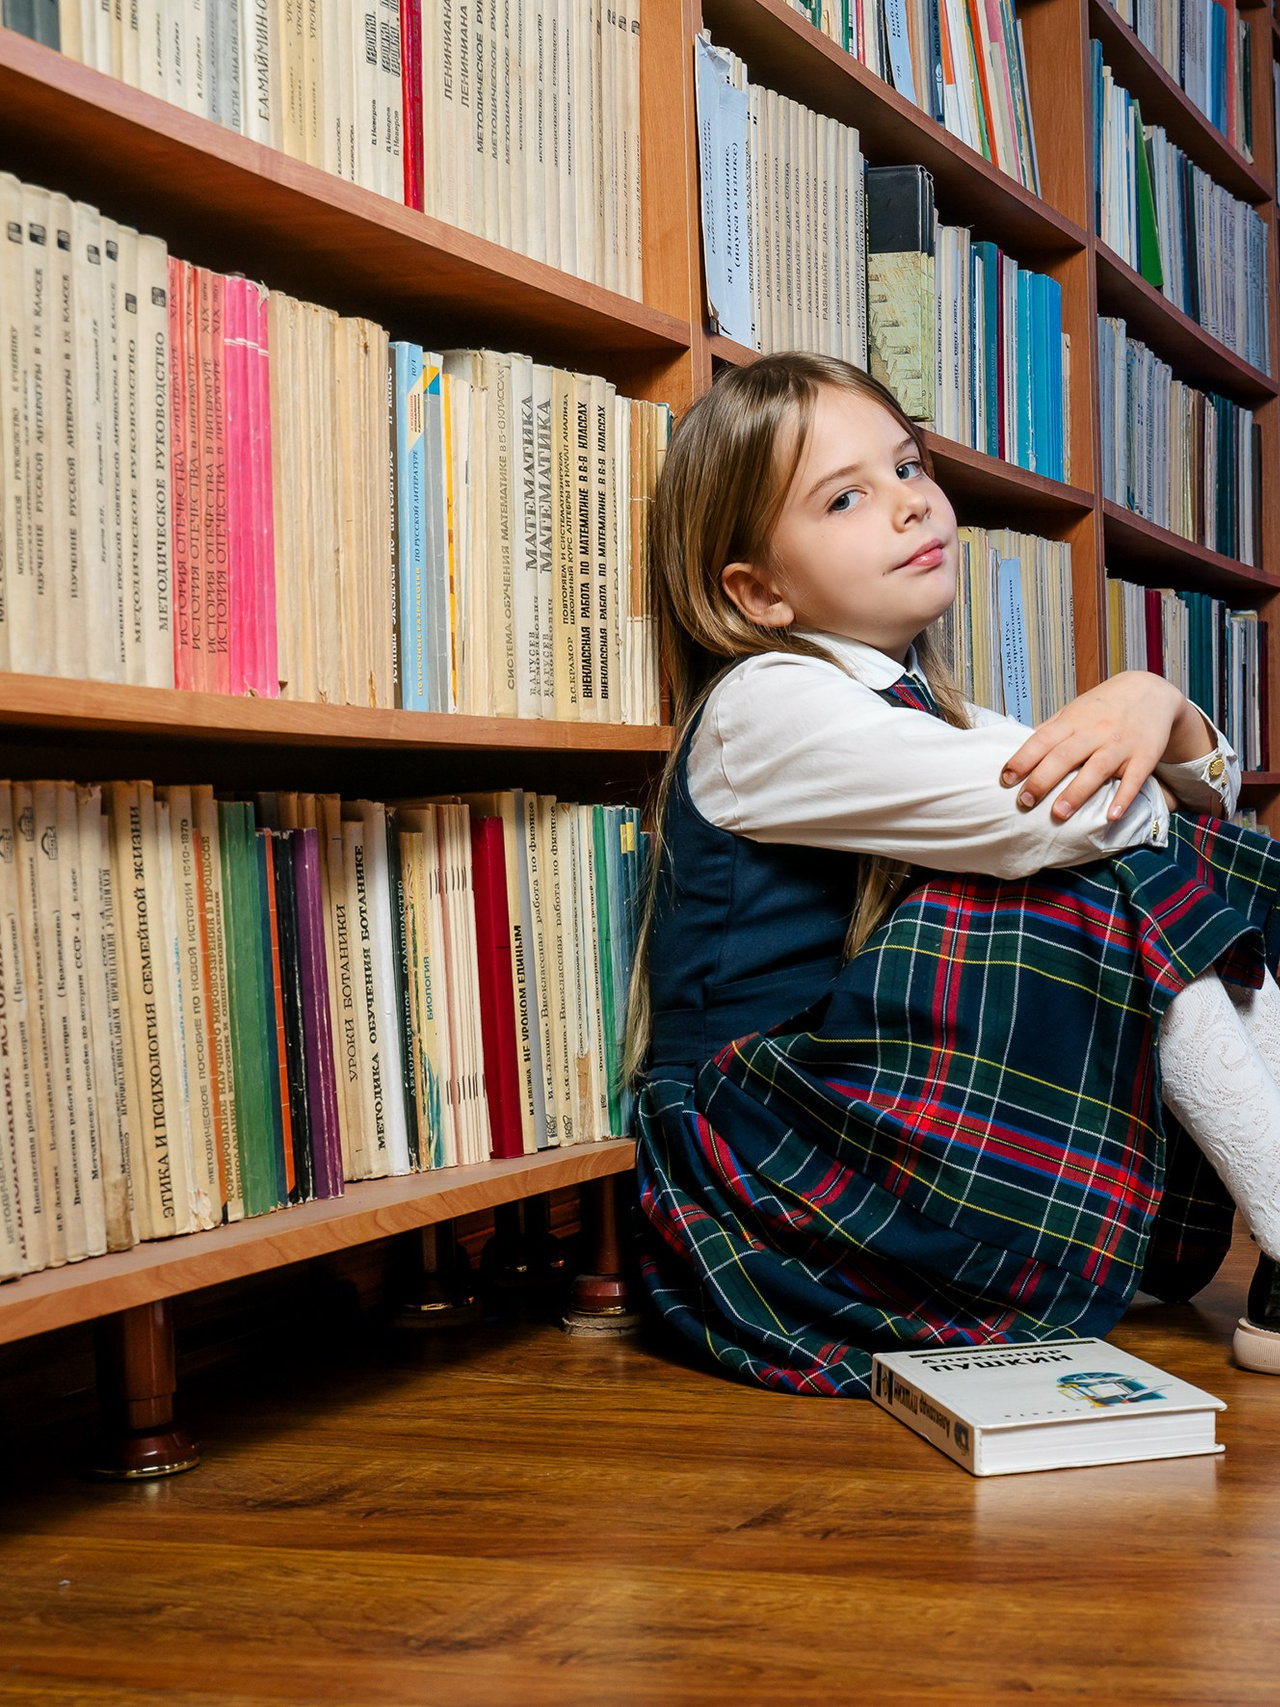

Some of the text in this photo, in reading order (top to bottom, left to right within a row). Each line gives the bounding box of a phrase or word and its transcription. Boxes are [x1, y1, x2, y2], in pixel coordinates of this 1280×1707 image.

[231, 90, 240, 128] ПУТИ
[443, 0, 453, 101] ЛЕНИНИАНА
[460, 5, 470, 108] ЛЕНИНИАНА
[490, 40, 498, 160] МЕТОДИЧЕСКОЕ
[370, 99, 378, 136] Неверов
[392, 109, 400, 147] Неверов
[33, 268, 45, 595] ИЗУЧЕНИЕ РУССКОЙ ЛИТЕРАТУРЫ КЛАССЕ
[62, 274, 78, 598] ИЗУЧЕНИЕ РУССКОЙ ЛИТЕРАТУРЫ КЛАССЕ
[128, 339, 143, 643] МЕТОДИЧЕСКОЕ РУКОВОДСТВО
[155, 331, 169, 632] МЕТОДИЧЕСКОЕ РУКОВОДСТВО
[521, 393, 538, 572] МАТЕМАТИКА
[536, 398, 553, 575] МАТЕМАТИКА
[174, 452, 186, 553] ОТЕЧЕСТВА
[189, 457, 201, 650] ИСТОРИЯ ОТЕЧЕСТВА
[202, 357, 217, 654] ИСТОРИЯ ОТЕЧЕСТВА ЛИТЕРАТУРЕ
[214, 462, 227, 563] ОТЕЧЕСТВА
[413, 506, 421, 545] РУССКОЙ
[558, 451, 569, 625] ПОВТОРЯЕМ СИСТЕМАТИЗИРУЕМ
[564, 490, 572, 535] АЛГЕБРЫ
[577, 401, 593, 699] ВНЕКЛАССНАЯ РАБОТА ПО МАТЕМАТИКЕ КЛАССАХ
[597, 405, 609, 700] ВНЕКЛАССНАЯ РАБОТА ПО МАТЕМАТИКЕ КЛАССАХ
[176, 560, 189, 645] ИСТОРИЯ
[216, 569, 228, 653] ИСТОРИЯ
[499, 456, 516, 690] СИСТЕМА ОБУЧЕНИЯ МАТЕМАТИКЕ
[566, 565, 576, 625] ШКОЛЬНЫЙ
[1019, 647, 1027, 699] русского
[397, 880, 409, 974] САДОВОДСТВО
[527, 801, 550, 1019] Внеклассная работа по физике
[549, 805, 567, 1020] Внеклассная работа физике
[61, 1017, 71, 1063] истории
[70, 868, 99, 1180] Методическое пособие истории СССР класс
[130, 806, 175, 1220] ЭТИКА И ПСИХОЛОГИЯ СЕМЕЙНОЙ ЖИЗНИ
[185, 881, 215, 1185] МЕТОДИЧЕСКОЕ ПОСОБИЕ ПО НОВОЙ ИСТОРИИ
[201, 836, 236, 1203] ФОРМИРОВАНИЕ НАУЧНОГО МИРОВОЗЗРЕНИЯ ПРОЦЕССЕ
[336, 904, 358, 1083] УРОКИ БОТАНИКИ
[354, 845, 386, 1150] МЕТОДИКА ОБУЧЕНИЯ БОТАНИКЕ
[423, 956, 434, 1020] БИОЛОГИЯ
[513, 924, 532, 1062] НЕ УРОКОМ ЕДИНЫМ
[595, 1008, 604, 1071] Физический
[65, 1085, 76, 1125] работа
[921, 1350, 1062, 1365] Александр
[929, 1354, 1074, 1372] ПУШКИН
